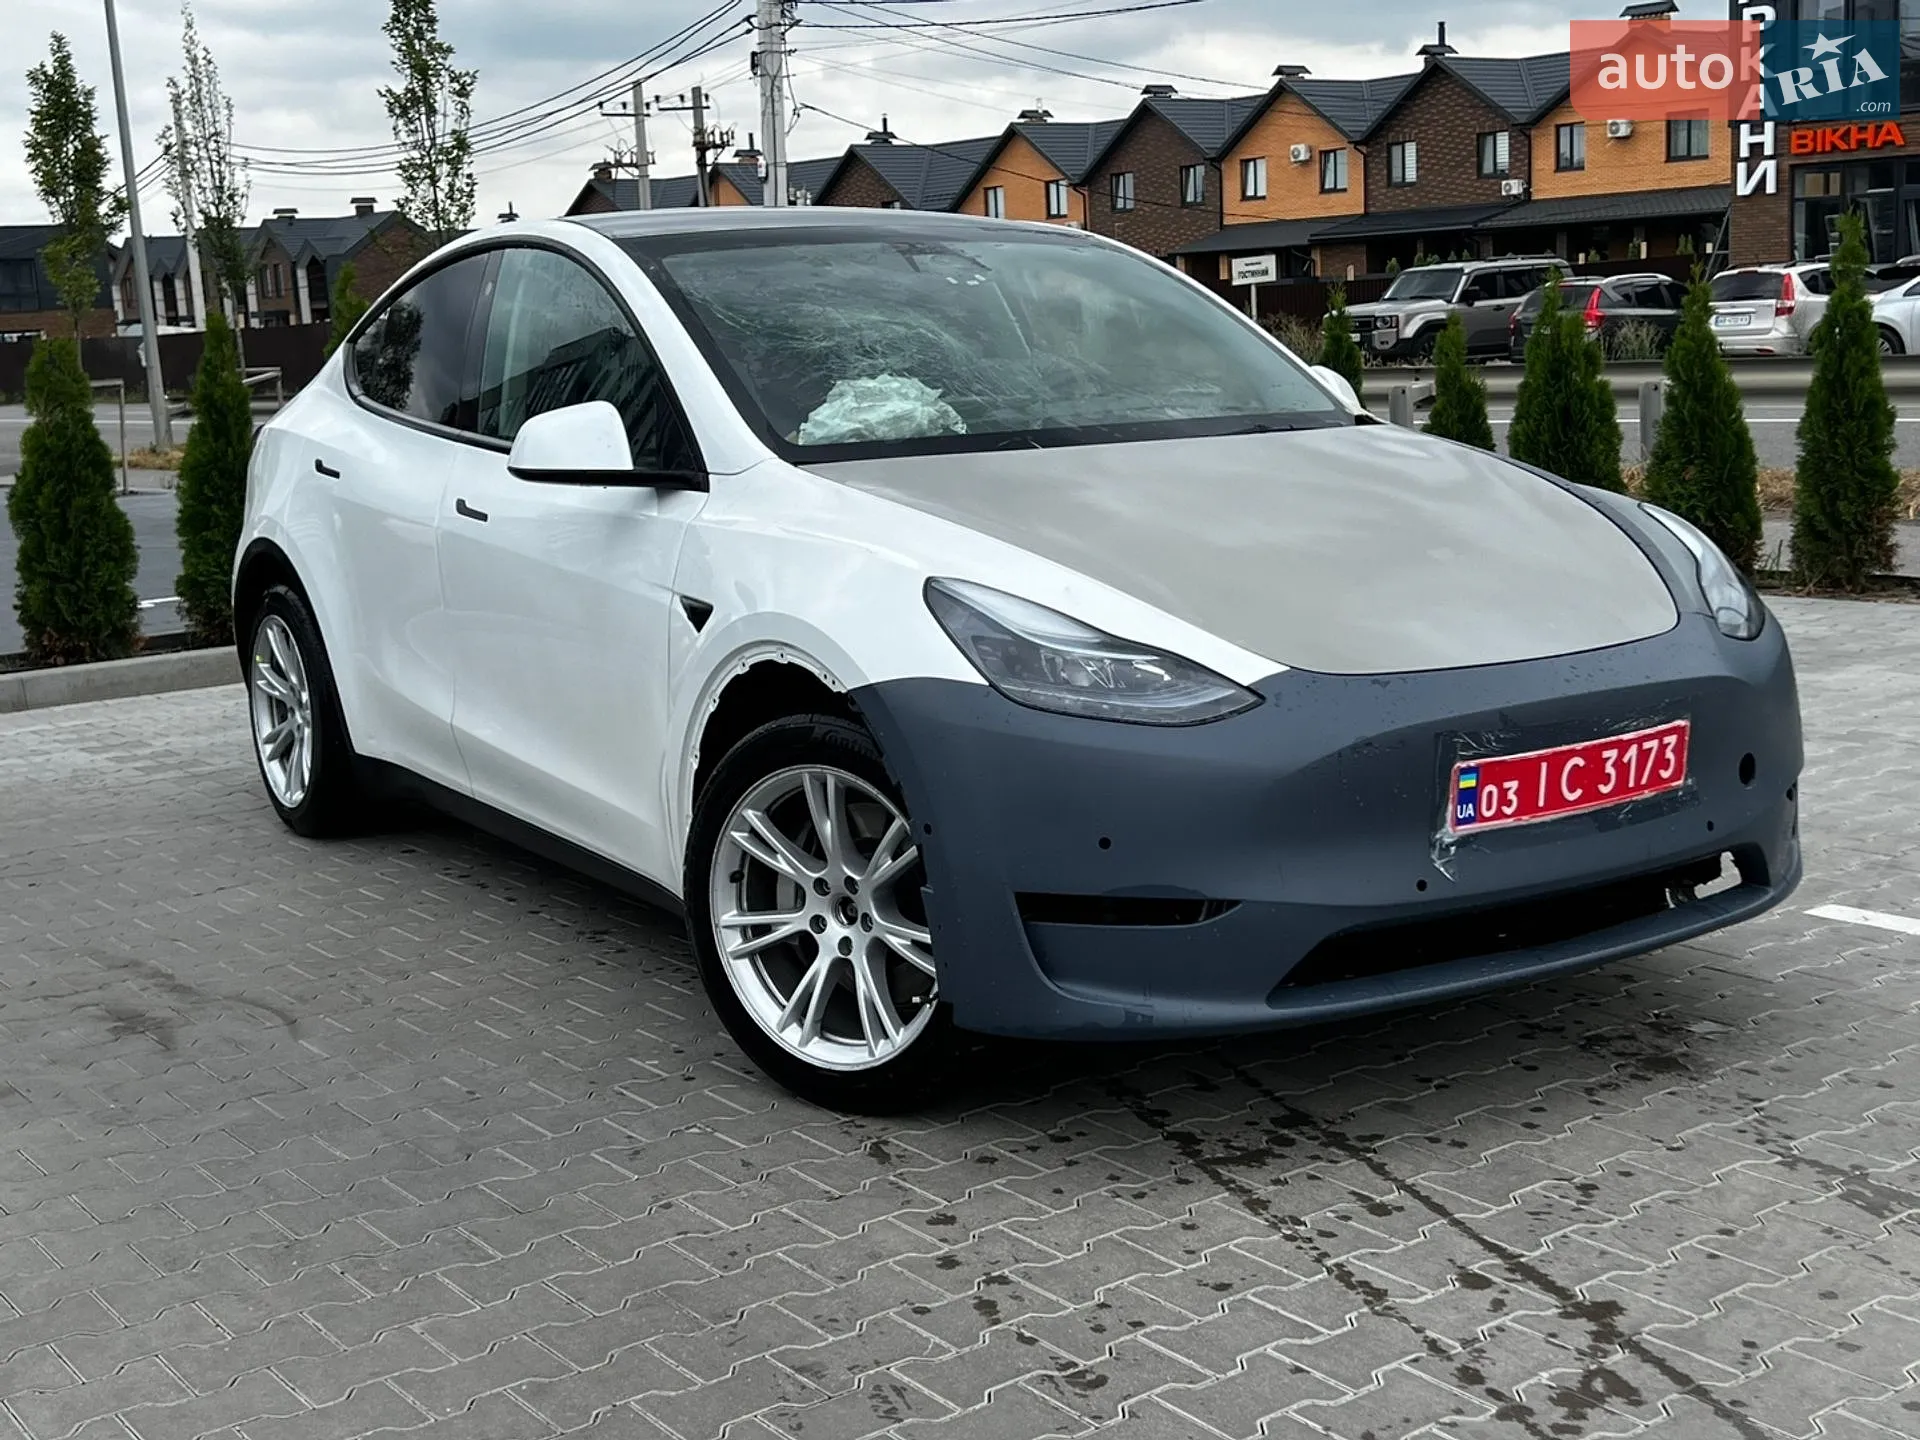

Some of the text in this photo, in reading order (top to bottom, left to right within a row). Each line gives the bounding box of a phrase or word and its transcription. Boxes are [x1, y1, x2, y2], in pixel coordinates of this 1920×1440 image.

[1736, 0, 1780, 197] РКАНИ
[1789, 121, 1907, 156] ВІКНА
[1480, 780, 1518, 818] 03
[1597, 734, 1678, 795] 3173
[1457, 803, 1475, 819] UA
